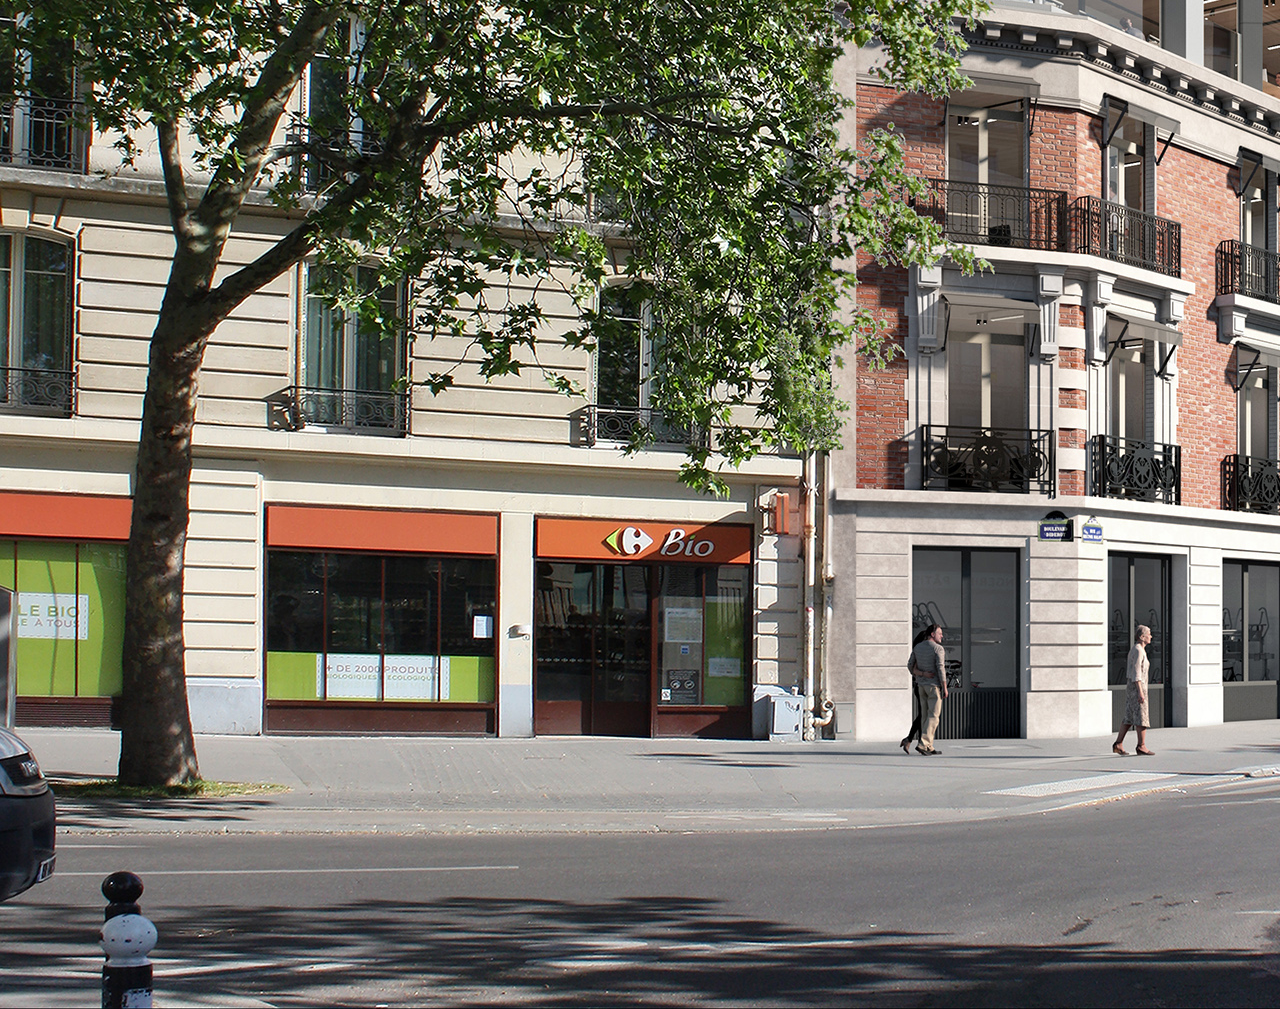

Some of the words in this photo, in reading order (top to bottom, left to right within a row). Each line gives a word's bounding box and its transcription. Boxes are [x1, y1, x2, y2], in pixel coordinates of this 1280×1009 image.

[660, 528, 714, 556] Bio
[48, 605, 79, 618] BIO
[355, 665, 381, 673] 2000
